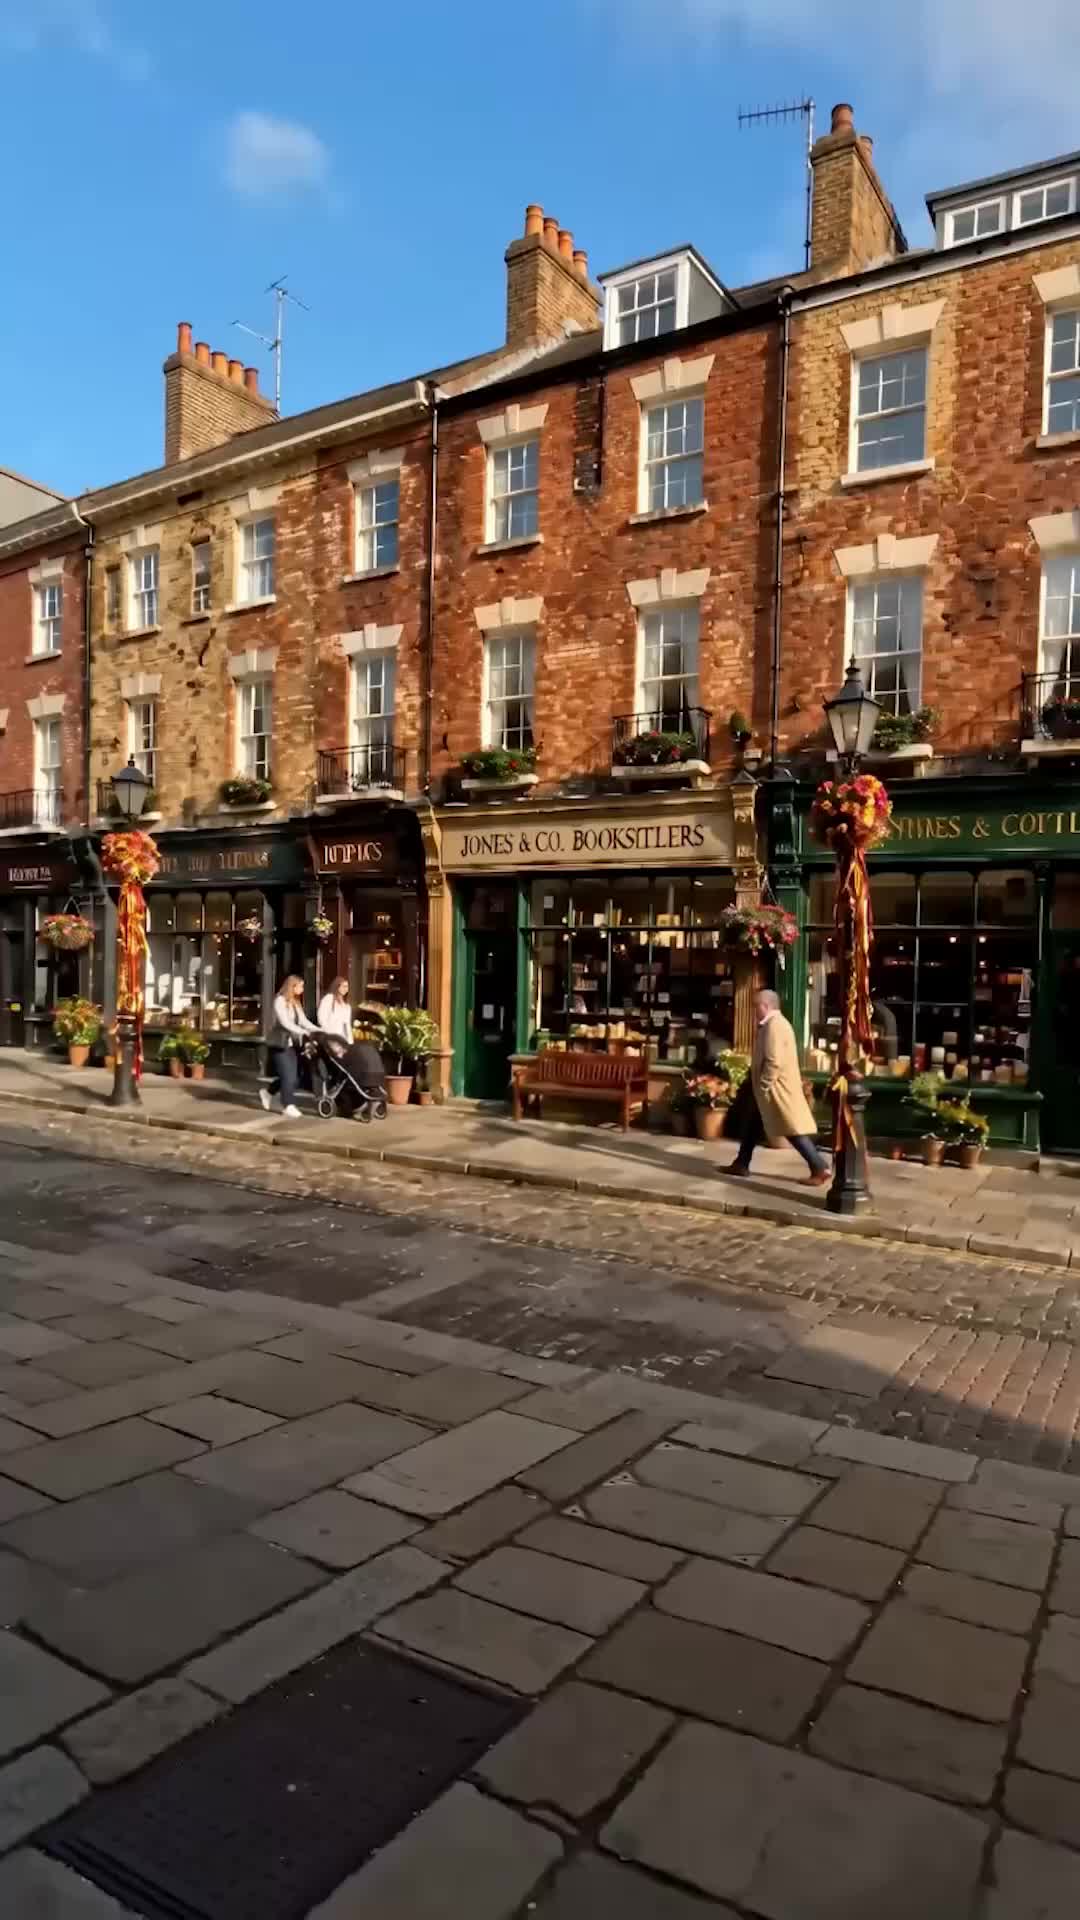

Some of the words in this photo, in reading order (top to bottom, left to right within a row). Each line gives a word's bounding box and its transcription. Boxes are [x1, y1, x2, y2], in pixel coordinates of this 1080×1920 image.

[972, 815, 991, 838] &
[461, 832, 514, 857] JONES
[519, 832, 531, 853] &
[536, 830, 565, 852] CO.
